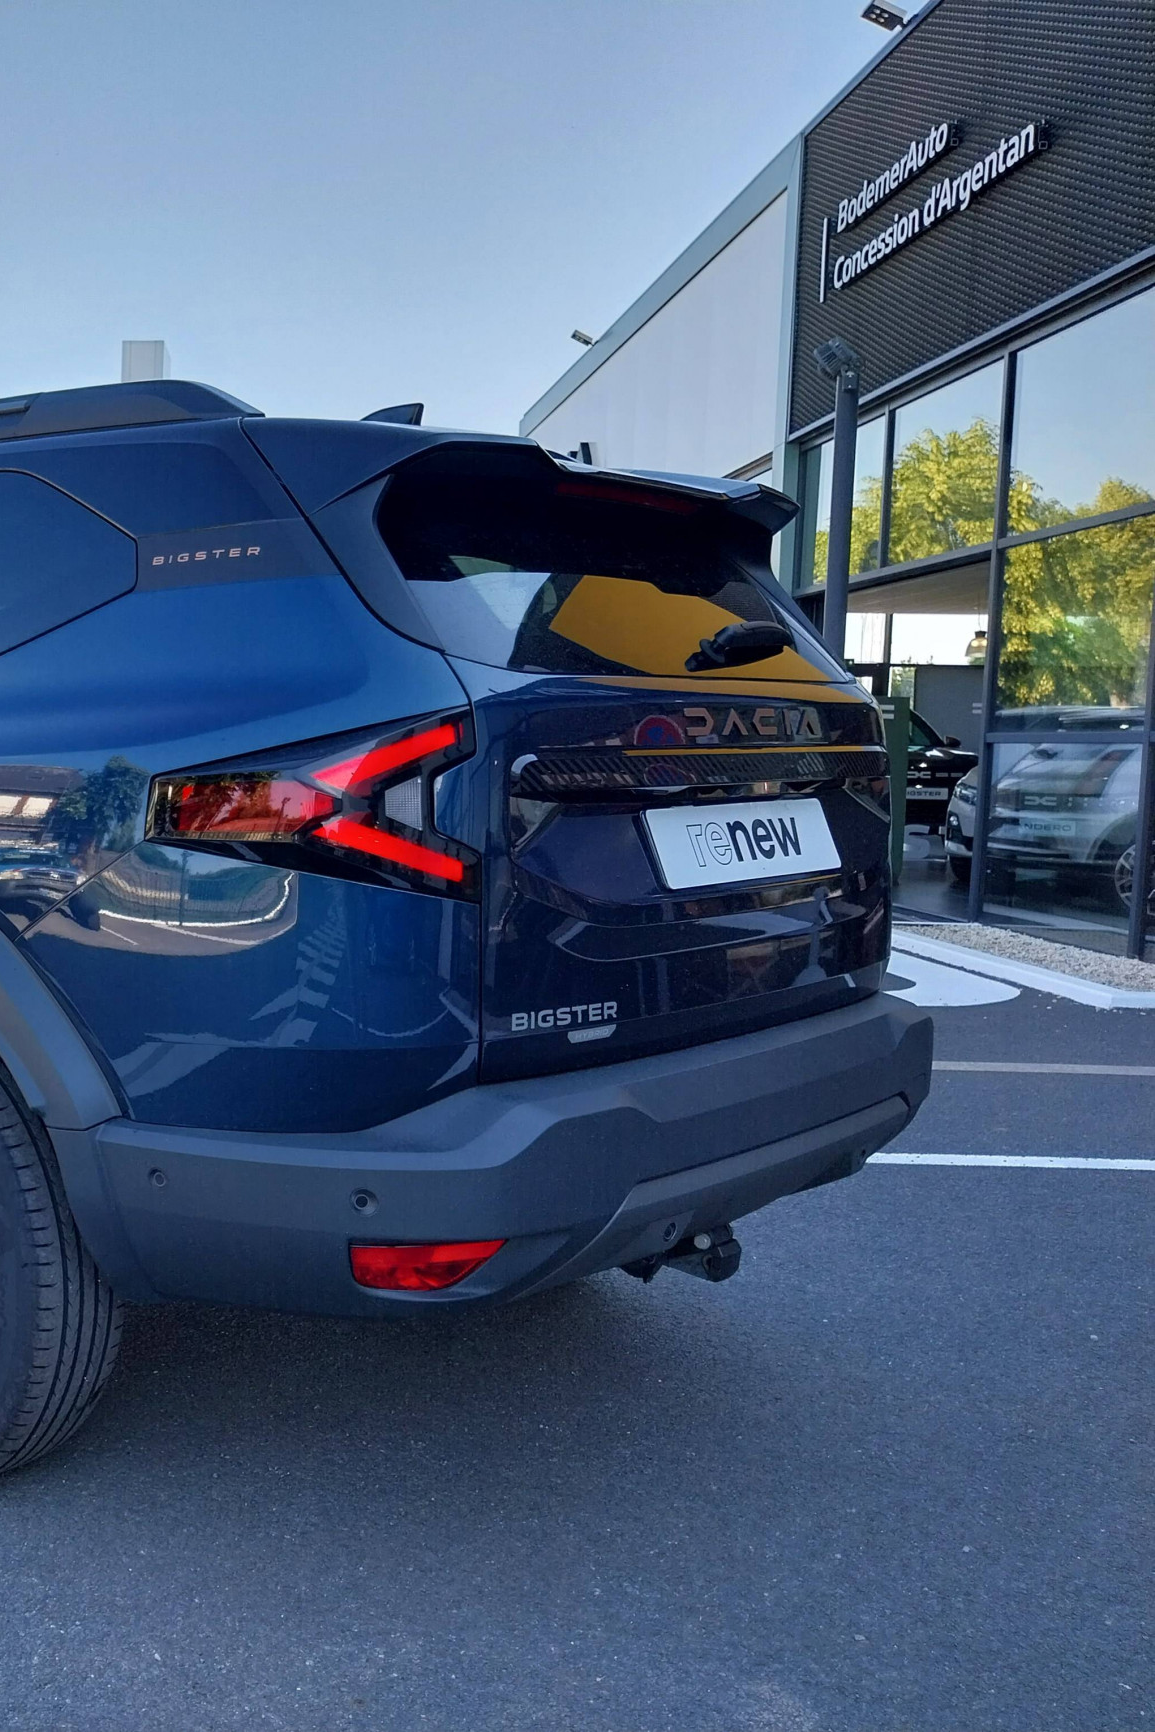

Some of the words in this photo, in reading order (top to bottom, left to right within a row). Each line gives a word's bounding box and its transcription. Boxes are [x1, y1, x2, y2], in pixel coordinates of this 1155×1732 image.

[837, 123, 948, 234] BodemerAuto
[833, 212, 919, 289] Concession
[923, 124, 1035, 226] d'Argentan
[152, 546, 261, 566] BIGSTER
[683, 707, 820, 737] DACIA
[686, 816, 802, 868] renew
[511, 1001, 618, 1032] BIGSTER
